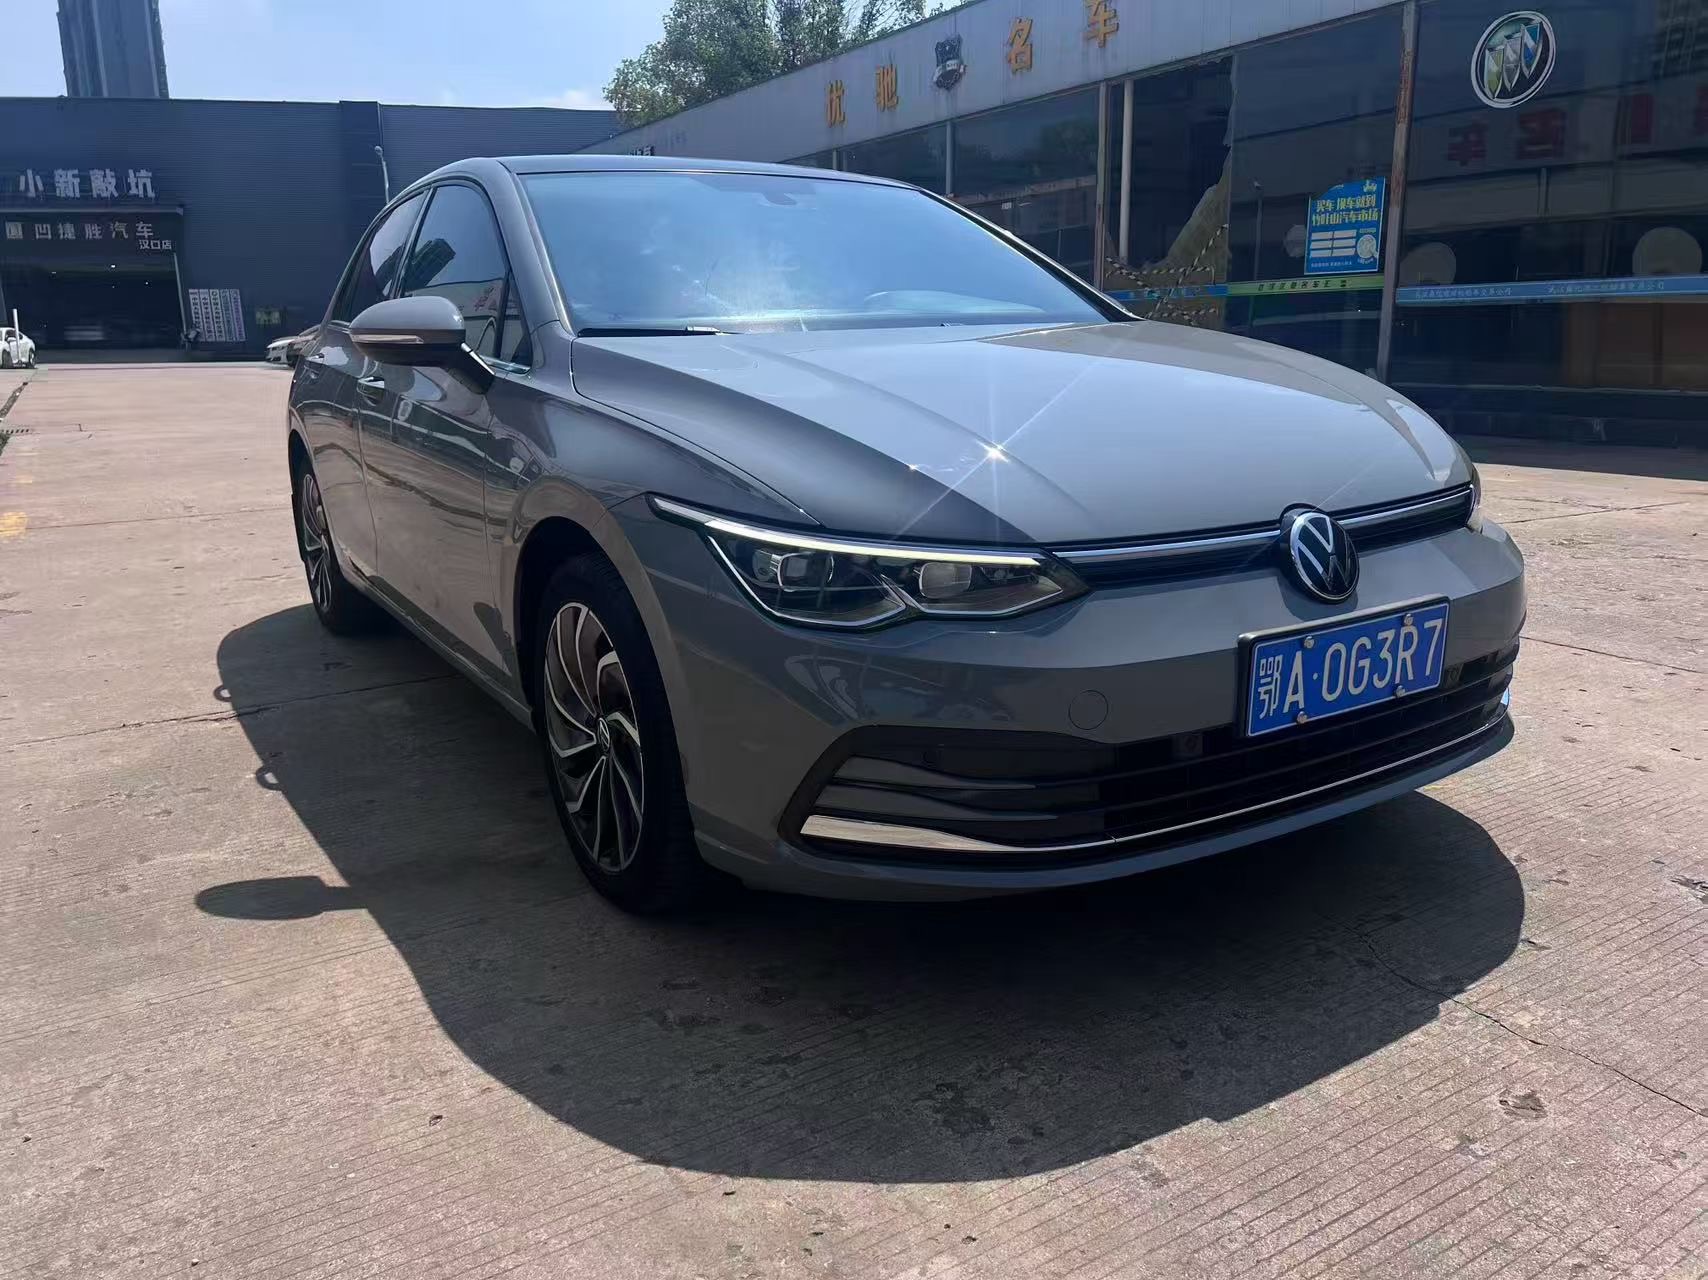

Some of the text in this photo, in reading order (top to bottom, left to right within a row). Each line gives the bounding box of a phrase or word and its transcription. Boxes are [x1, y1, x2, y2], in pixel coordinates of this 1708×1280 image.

[19, 168, 156, 198] 小新敲坑
[139, 239, 172, 250] 汉口店
